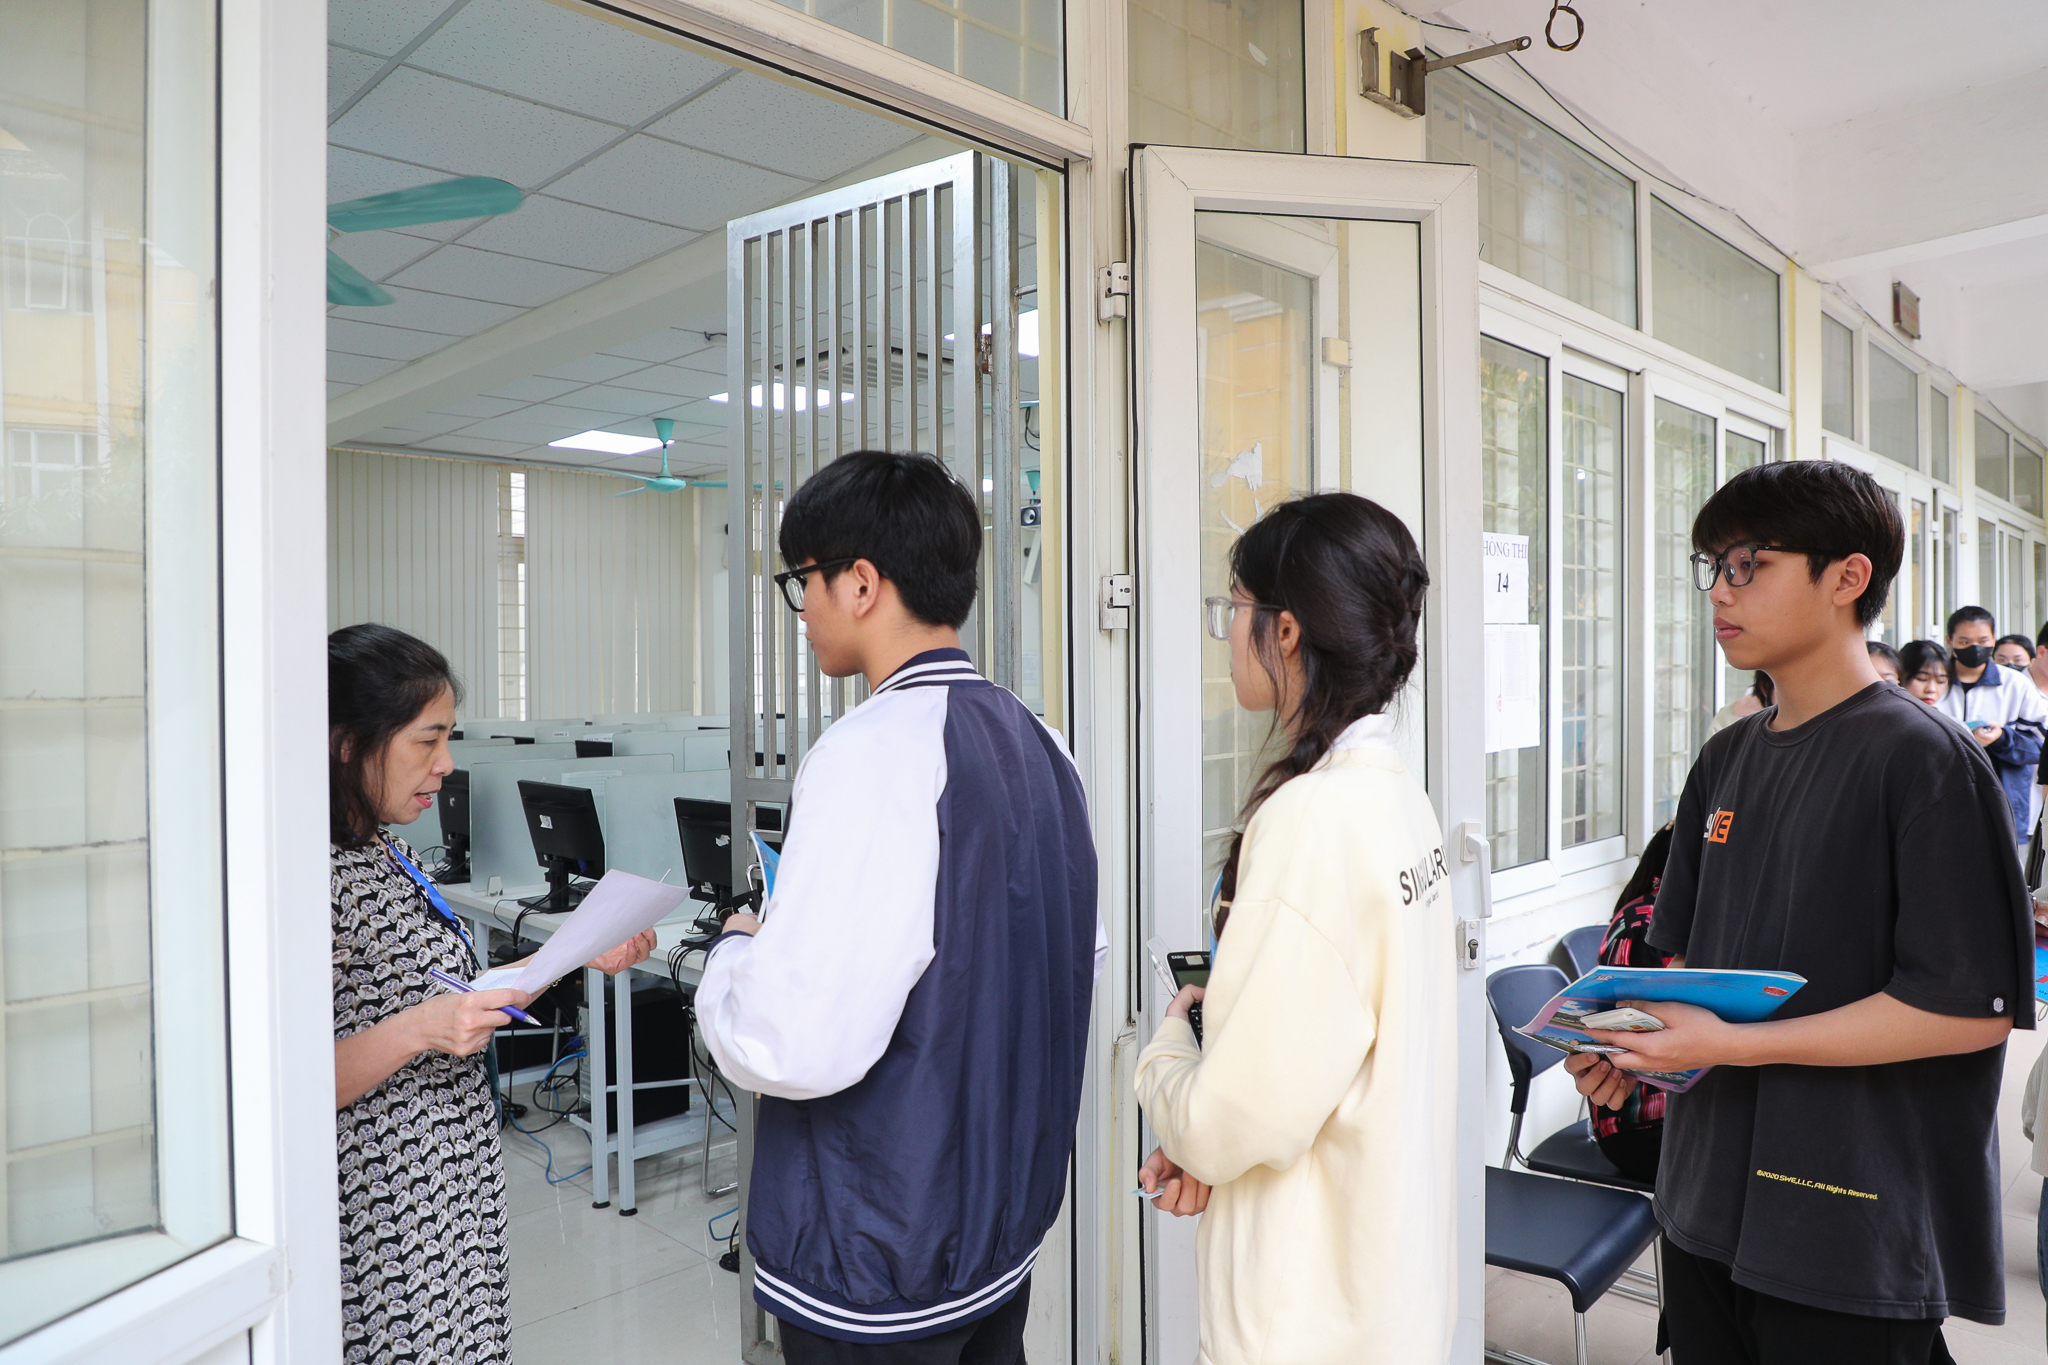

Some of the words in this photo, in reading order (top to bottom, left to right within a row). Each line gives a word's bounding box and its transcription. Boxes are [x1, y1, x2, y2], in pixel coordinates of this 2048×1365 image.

[1483, 536, 1510, 557] HÒNG
[1512, 543, 1527, 559] THI
[1497, 572, 1508, 593] 14
[1814, 1182, 1826, 1190] All
[1826, 1184, 1847, 1194] Rights
